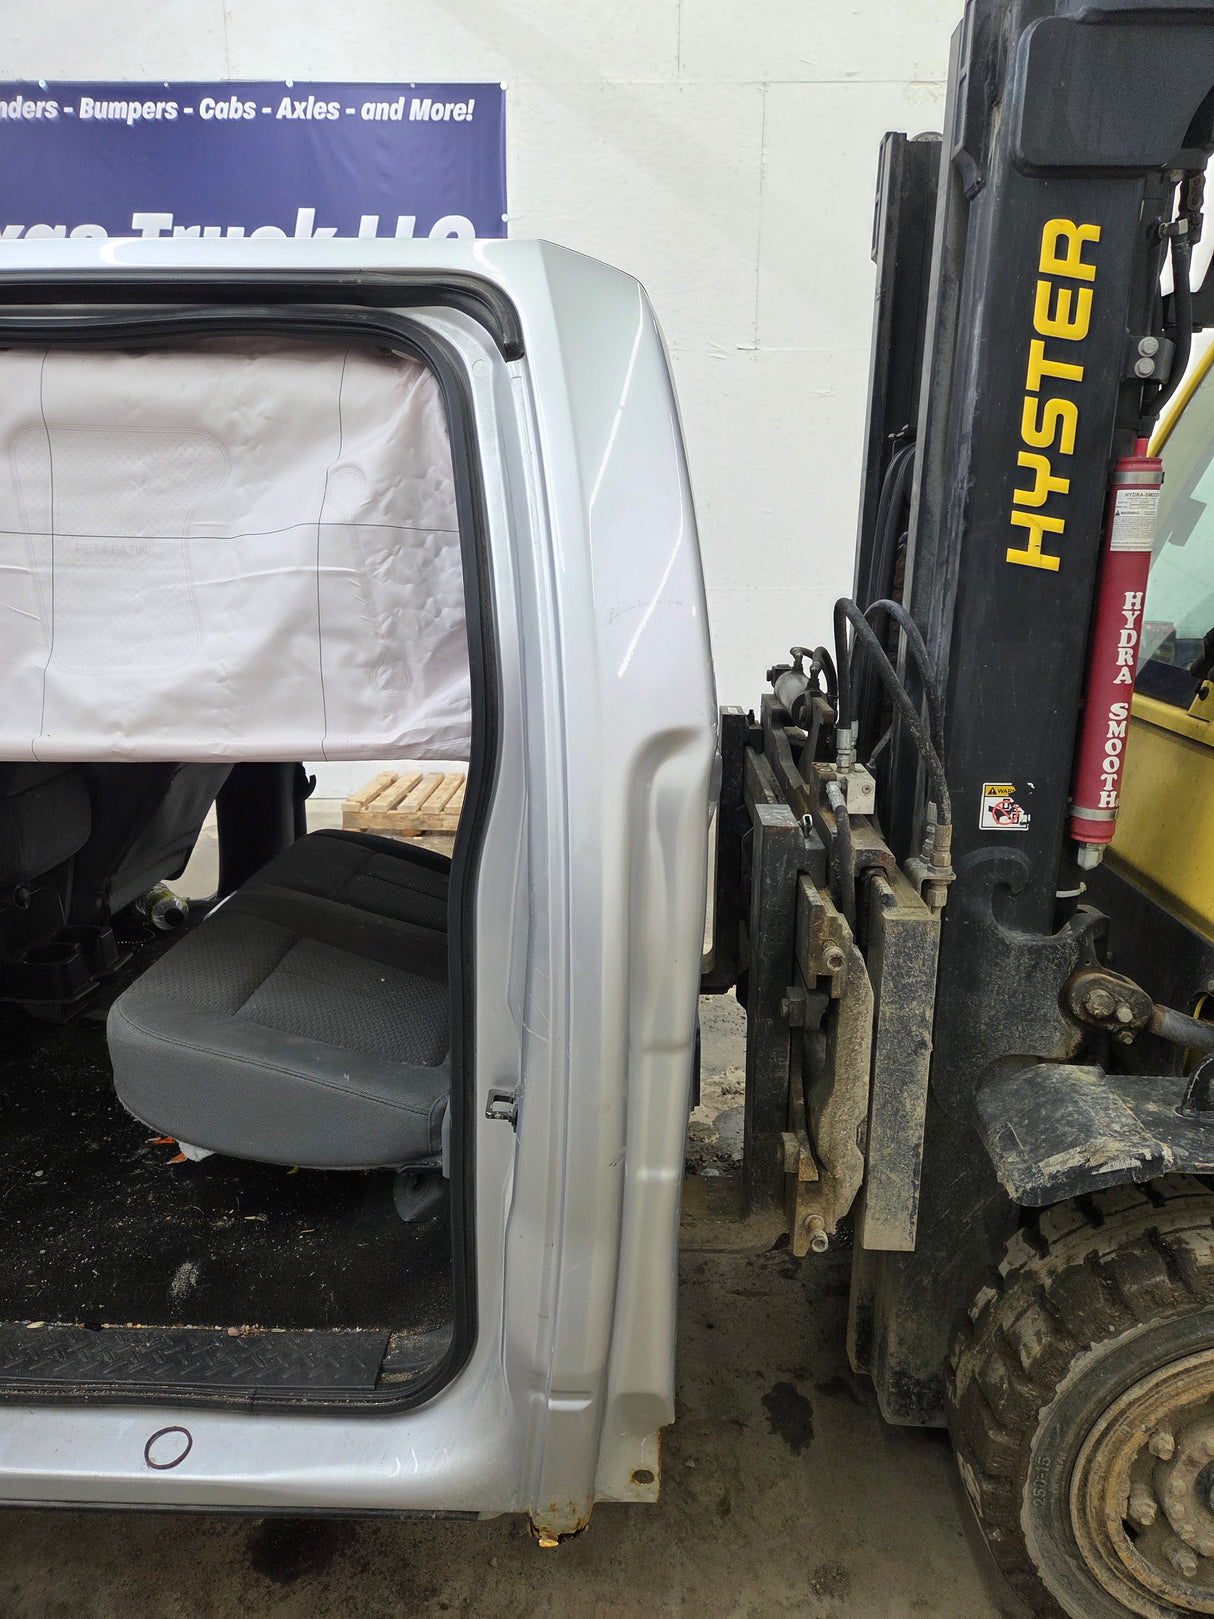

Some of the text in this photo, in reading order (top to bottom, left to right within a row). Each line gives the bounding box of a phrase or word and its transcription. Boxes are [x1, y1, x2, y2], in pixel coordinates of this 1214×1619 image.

[80, 96, 179, 126] Bumpers
[199, 95, 257, 120] Cabs
[275, 95, 341, 121] Axles
[361, 96, 405, 121] and
[409, 98, 476, 122] More!
[1006, 218, 1101, 572] HYSTER
[1098, 591, 1143, 808] HYDRA SMOOTH
